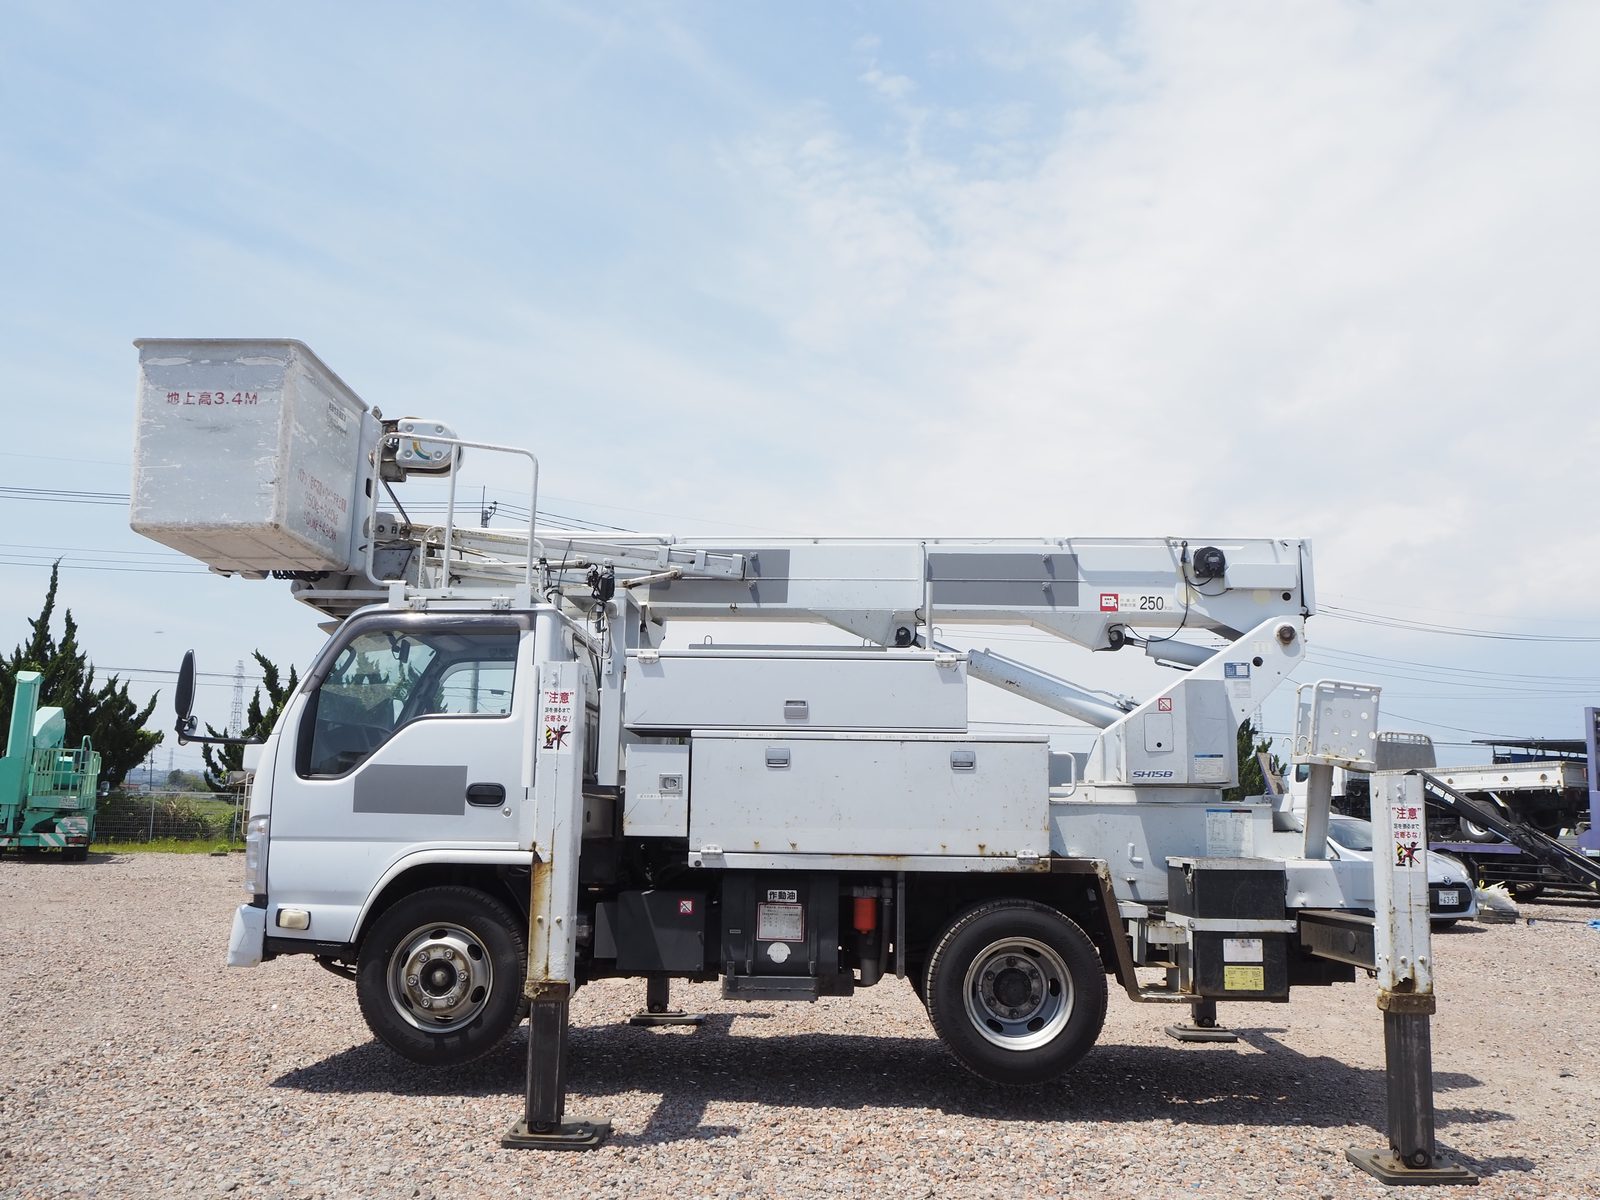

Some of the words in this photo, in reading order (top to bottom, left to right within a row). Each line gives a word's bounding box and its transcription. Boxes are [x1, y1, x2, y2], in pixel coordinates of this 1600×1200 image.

[166, 391, 258, 406] 地上高3.4M
[1139, 596, 1164, 610] 250
[769, 891, 796, 900] 作動油
